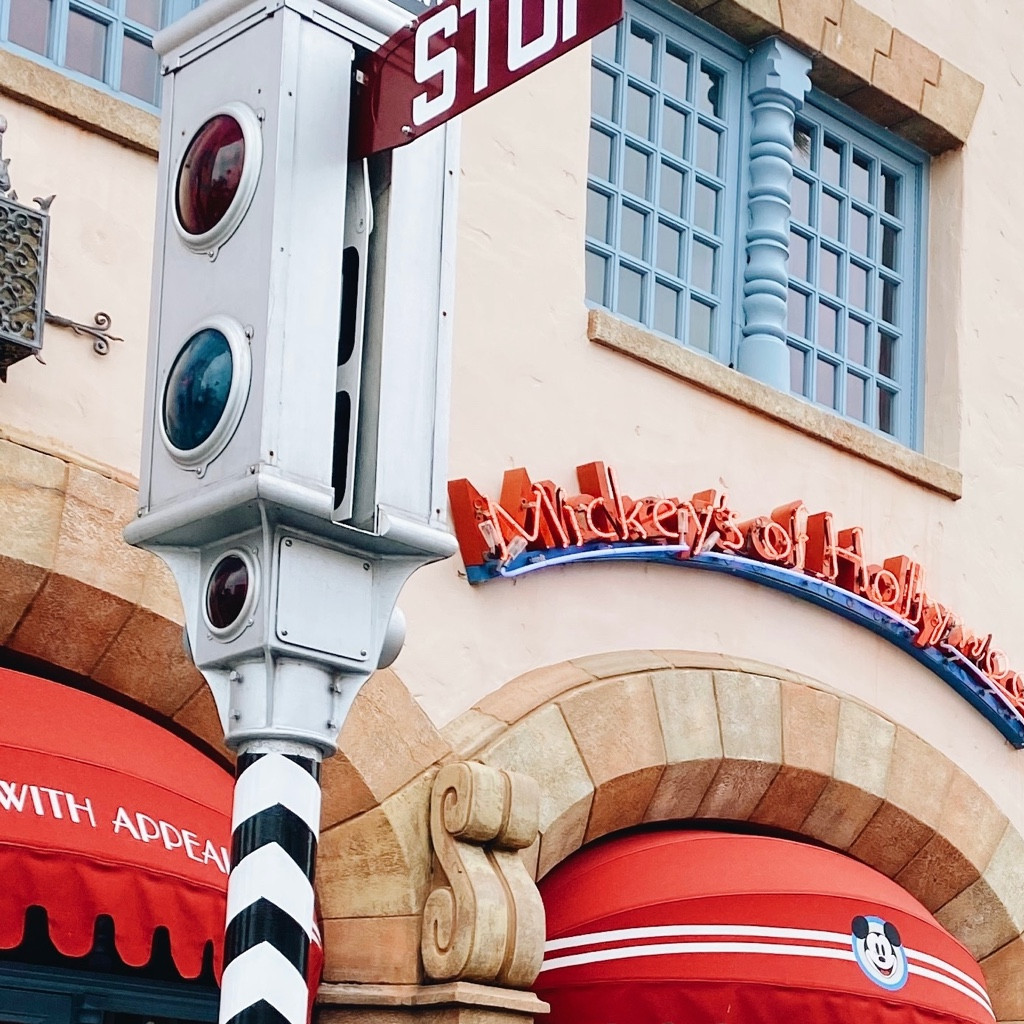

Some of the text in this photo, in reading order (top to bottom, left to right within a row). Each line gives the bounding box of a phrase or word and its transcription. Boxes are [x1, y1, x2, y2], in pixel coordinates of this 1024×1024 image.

[448, 461, 745, 567] Mickey's
[742, 502, 809, 572] of
[0, 780, 97, 828] WITH
